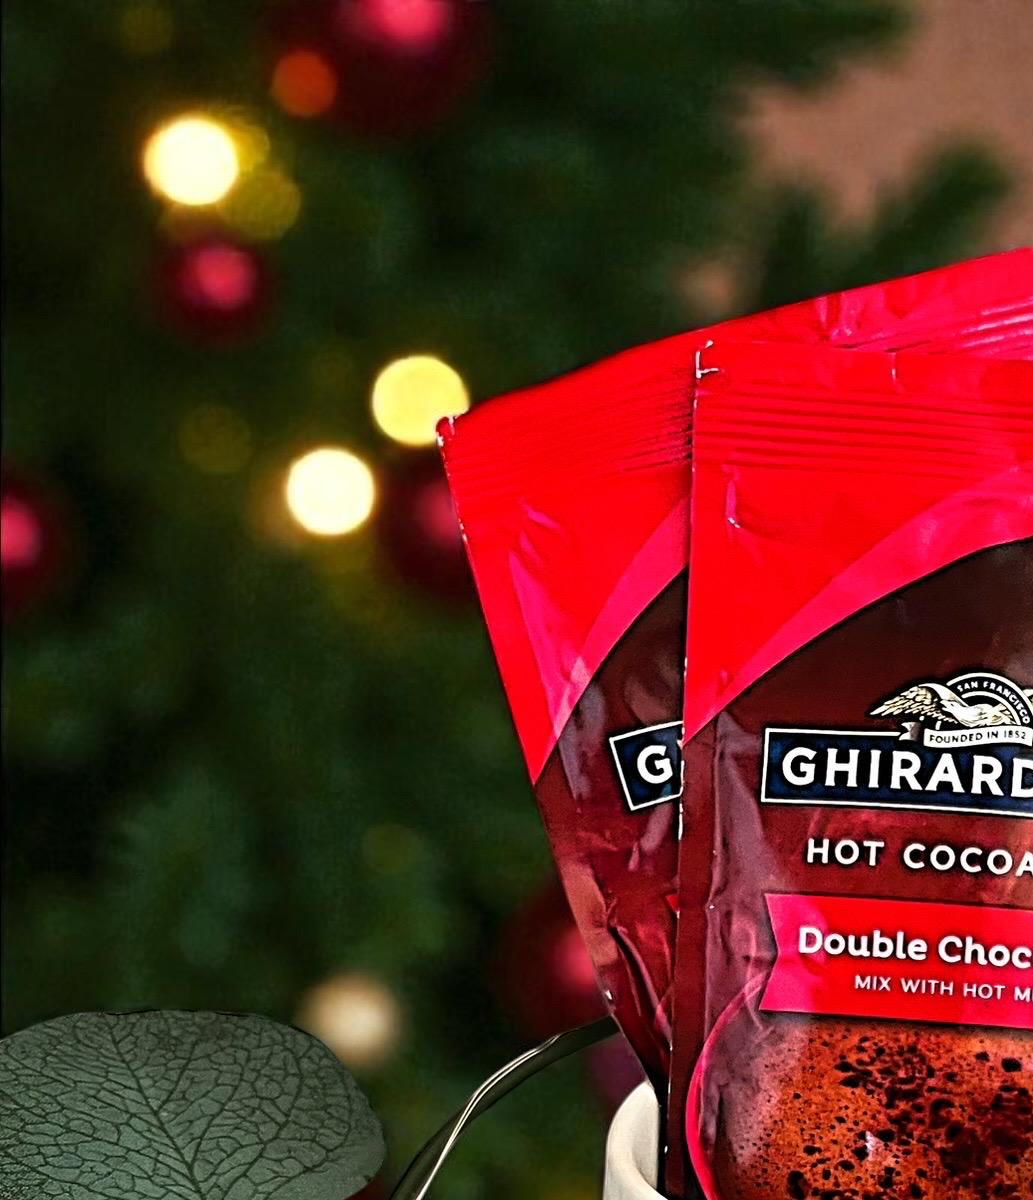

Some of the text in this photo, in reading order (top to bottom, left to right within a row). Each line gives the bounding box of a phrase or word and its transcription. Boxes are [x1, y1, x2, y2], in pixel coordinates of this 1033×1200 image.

[957, 681, 1031, 724] SAN FRANCISCO
[929, 729, 1027, 744] FOUNDED IN 1852
[806, 838, 885, 867] HOT
[798, 926, 928, 963] Double
[854, 974, 892, 992] MIX
[901, 977, 954, 996] WITH
[963, 982, 1006, 1000] HOT
